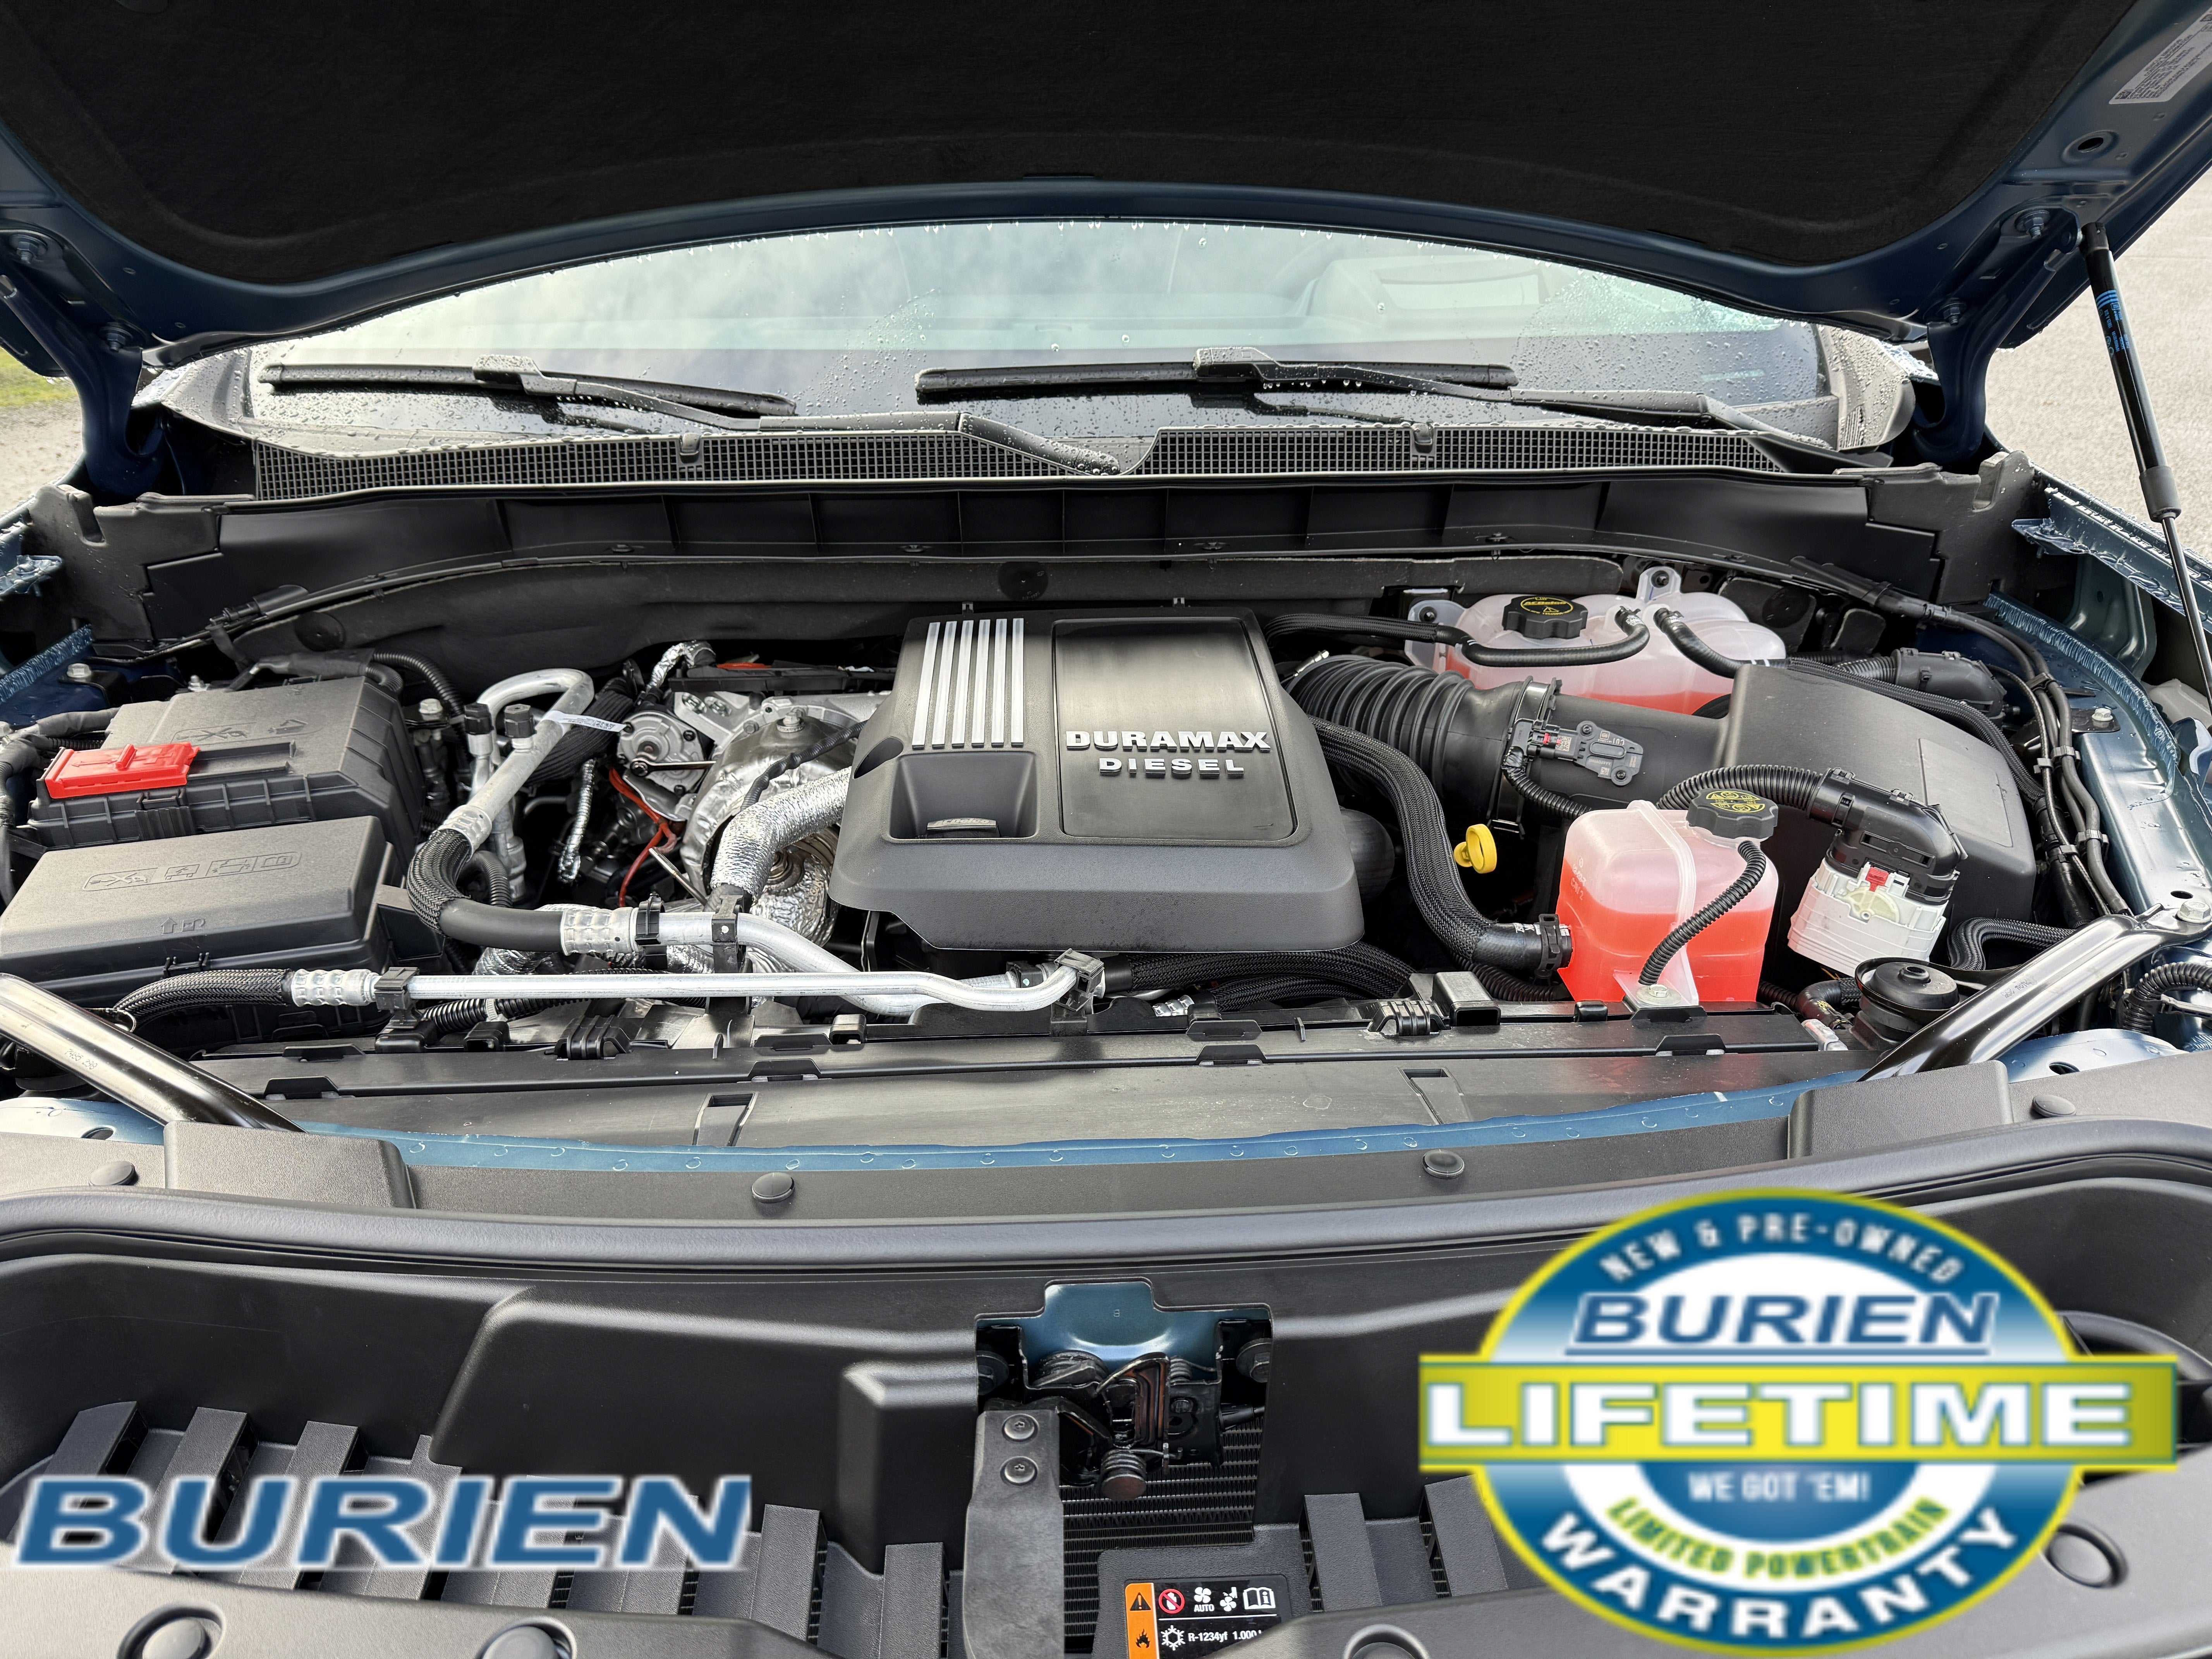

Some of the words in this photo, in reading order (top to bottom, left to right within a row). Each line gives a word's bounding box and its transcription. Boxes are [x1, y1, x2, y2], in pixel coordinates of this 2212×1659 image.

[1066, 731, 1270, 752] DURAMAX
[1099, 758, 1244, 775] DIESEL
[1188, 1631, 1228, 1642] R-1234yf
